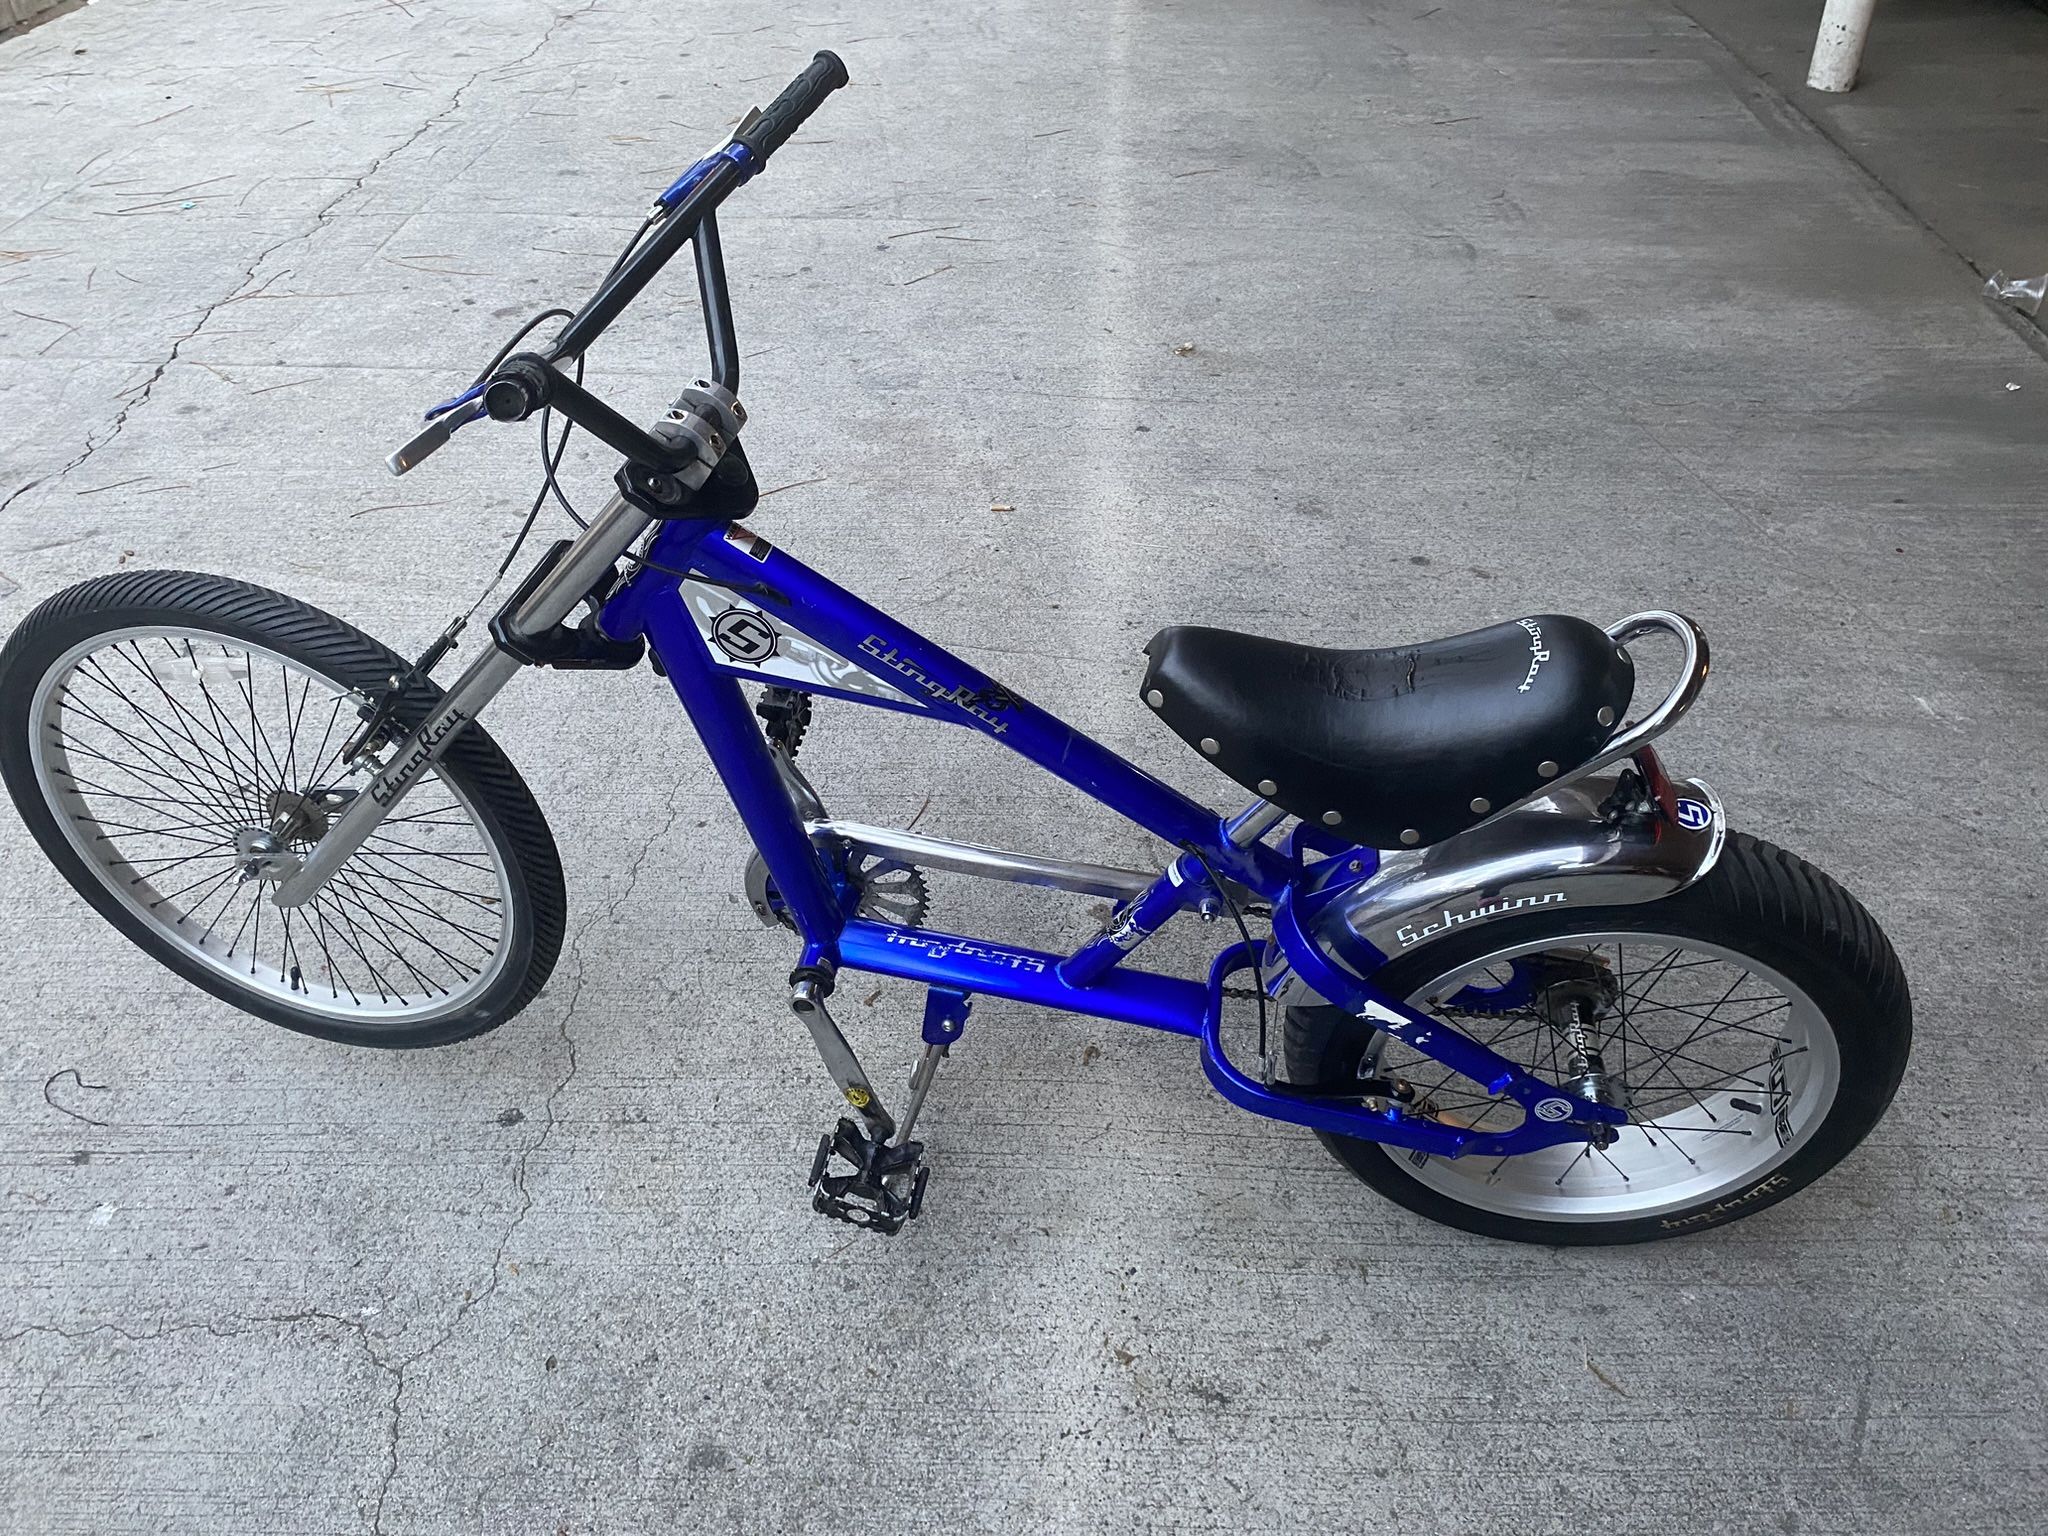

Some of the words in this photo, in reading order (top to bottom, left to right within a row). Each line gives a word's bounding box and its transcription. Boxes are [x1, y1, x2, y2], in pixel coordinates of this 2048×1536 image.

[857, 633, 1009, 735] StingRay
[1515, 618, 1551, 694] StingRay
[370, 708, 470, 808] StingRay
[1395, 892, 1568, 948] Schwinn
